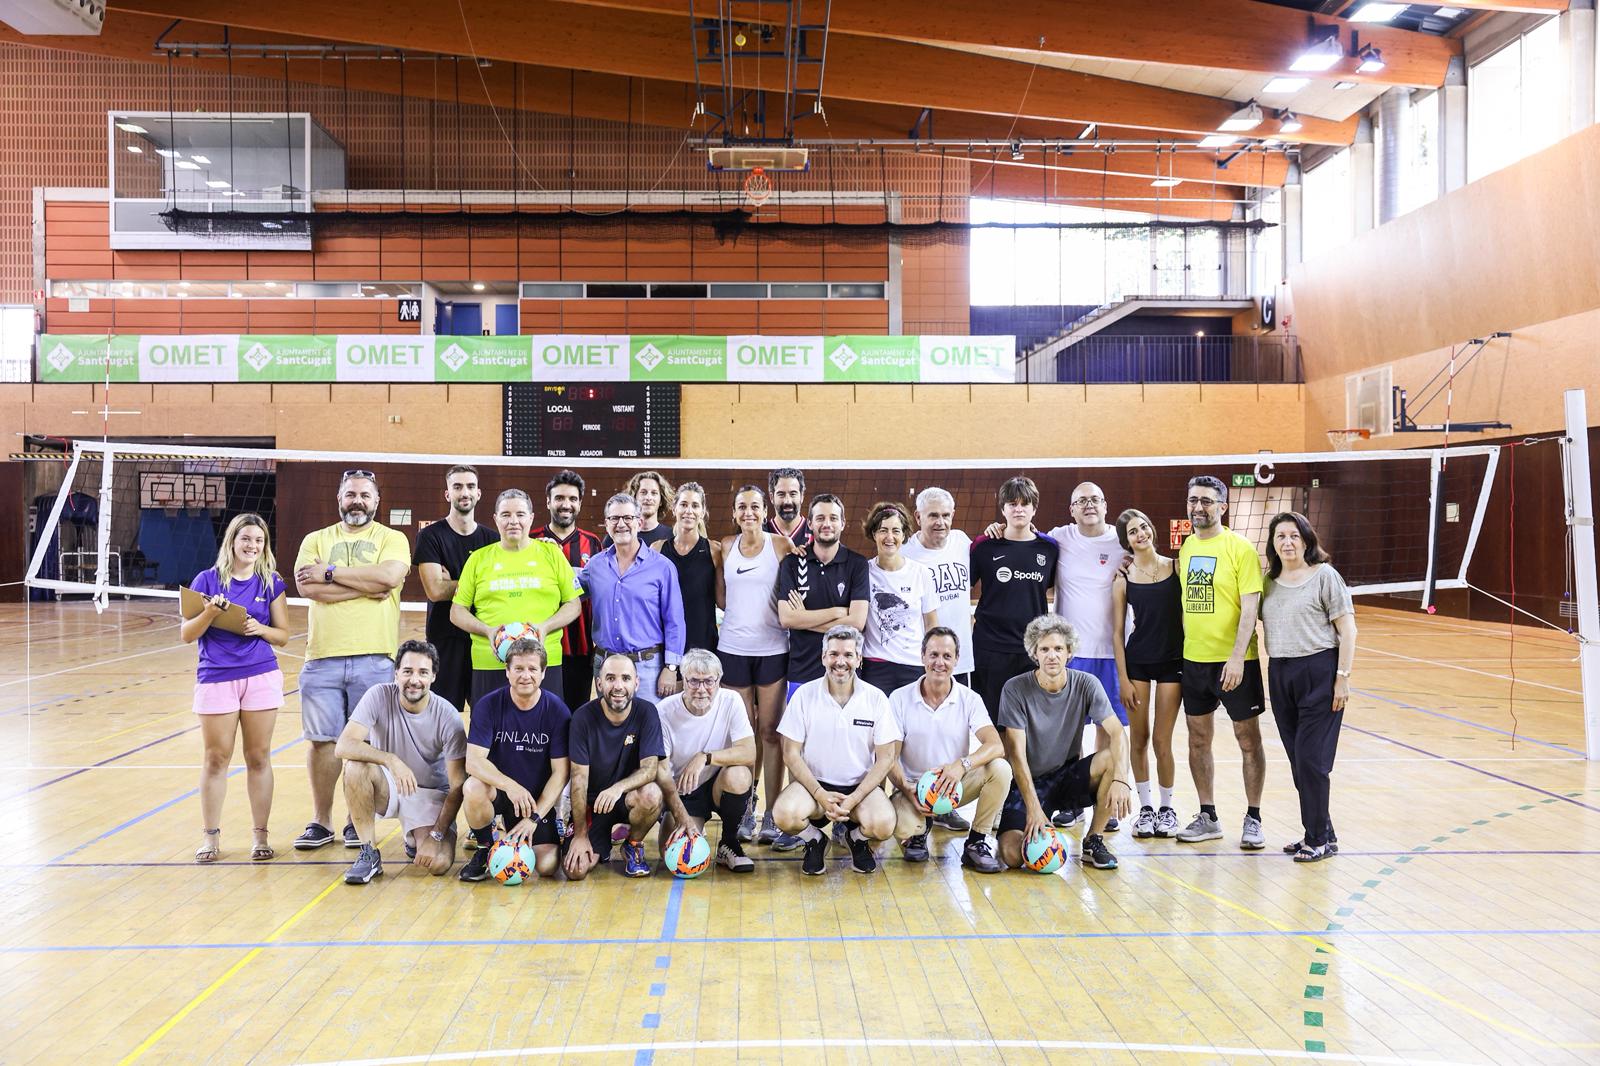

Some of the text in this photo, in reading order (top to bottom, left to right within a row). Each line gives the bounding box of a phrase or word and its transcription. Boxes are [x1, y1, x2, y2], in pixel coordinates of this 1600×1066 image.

[1263, 297, 1272, 324] C
[149, 345, 227, 366] OMET
[276, 356, 332, 367] SantCugat
[346, 345, 425, 365] OMET
[472, 356, 528, 367] SantCugat
[542, 345, 620, 365] OMET
[667, 356, 722, 366] SantCugat
[737, 345, 814, 365] OMET
[861, 356, 915, 367] SantCugat
[930, 346, 1005, 366] OMET
[547, 405, 573, 413] LOCAL
[612, 405, 635, 413] VISITANT
[1254, 461, 1275, 484] C
[1013, 570, 1044, 583] Spotify
[940, 592, 960, 602] DUBAI
[1188, 586, 1204, 600] CIMS
[494, 730, 550, 745] FINLAND
